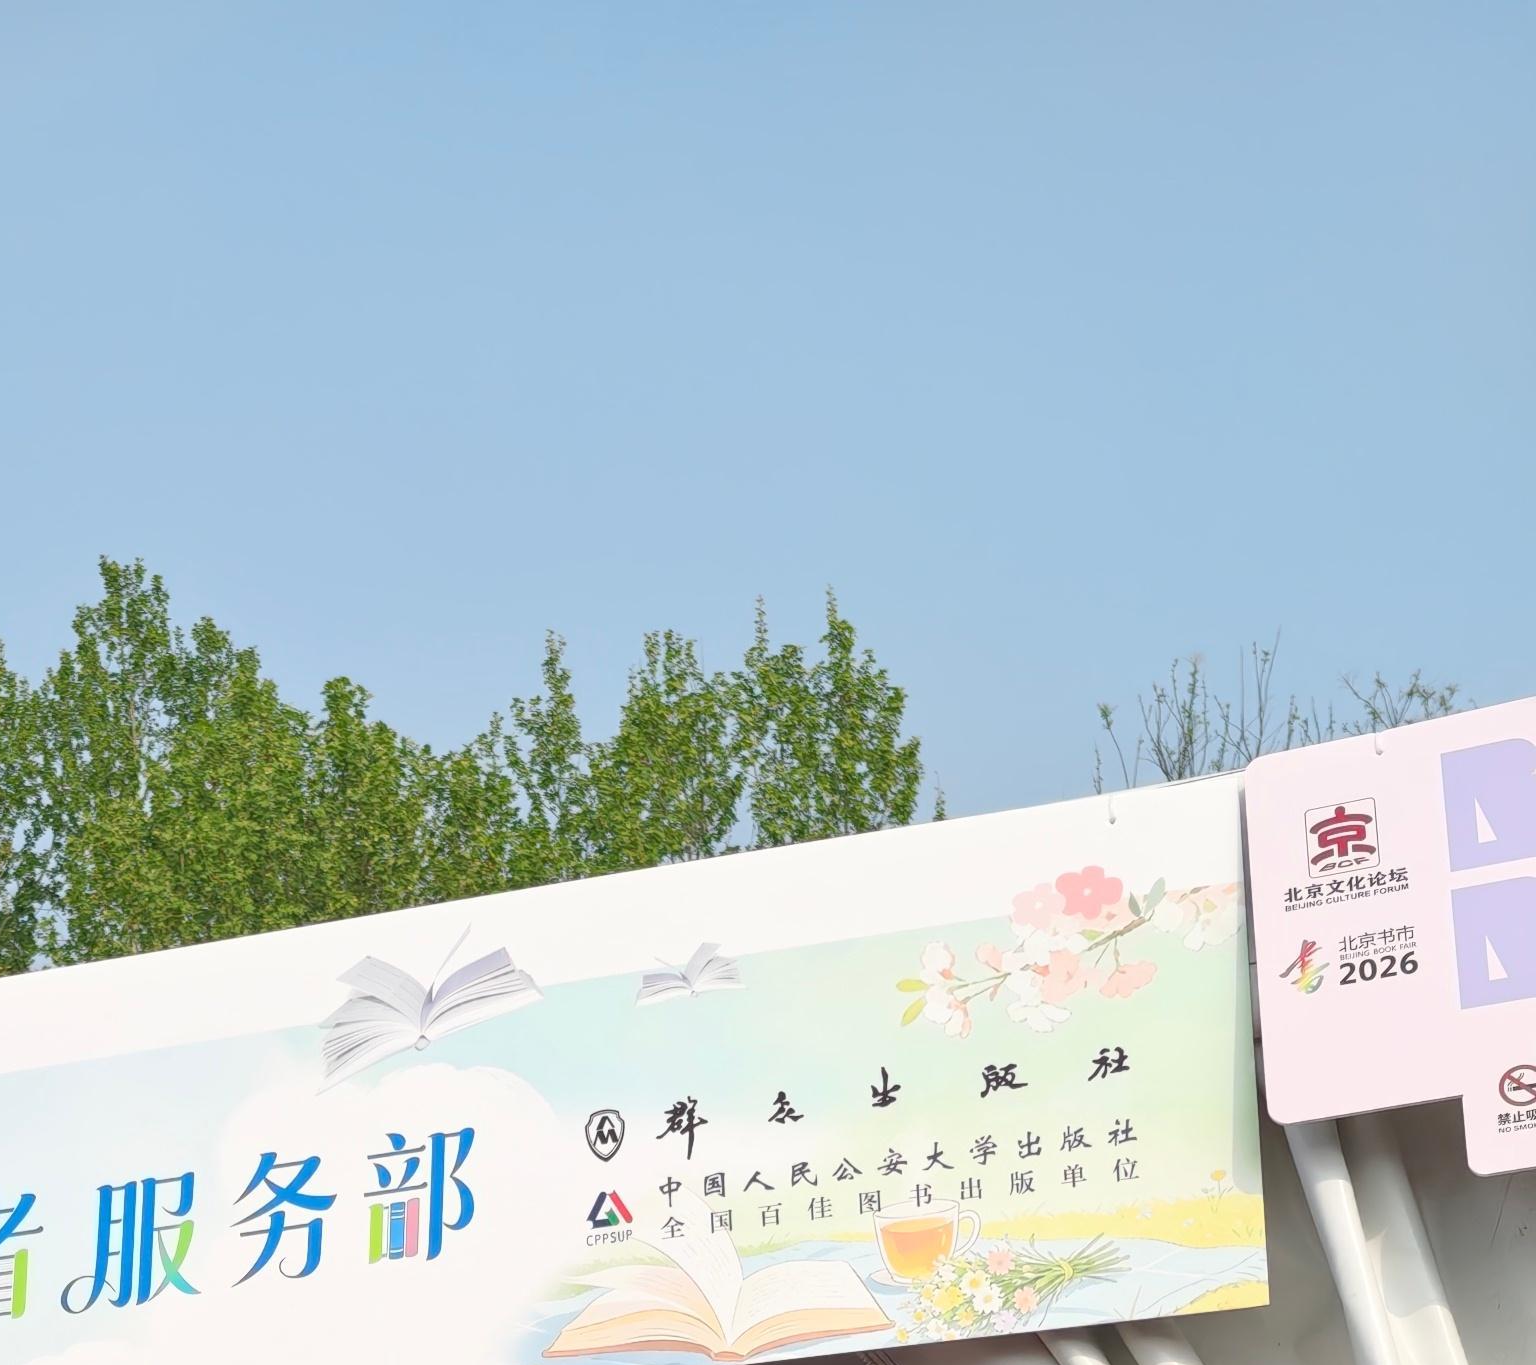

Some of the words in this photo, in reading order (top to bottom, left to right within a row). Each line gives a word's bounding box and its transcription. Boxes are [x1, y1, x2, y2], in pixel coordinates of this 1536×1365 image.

[1284, 867, 1410, 903] 北京文化论坛
[1285, 898, 1324, 912] BEIJING
[1326, 890, 1371, 907] CULTURE
[1373, 882, 1410, 899] FORUM
[1339, 925, 1415, 953] 北京书市
[1339, 951, 1419, 985] 2026
[658, 1119, 1138, 1208] 中国人民公安大学出版社
[661, 1157, 1141, 1240] 全国百佳图书出版单位
[586, 1229, 633, 1247] CPPSUP
